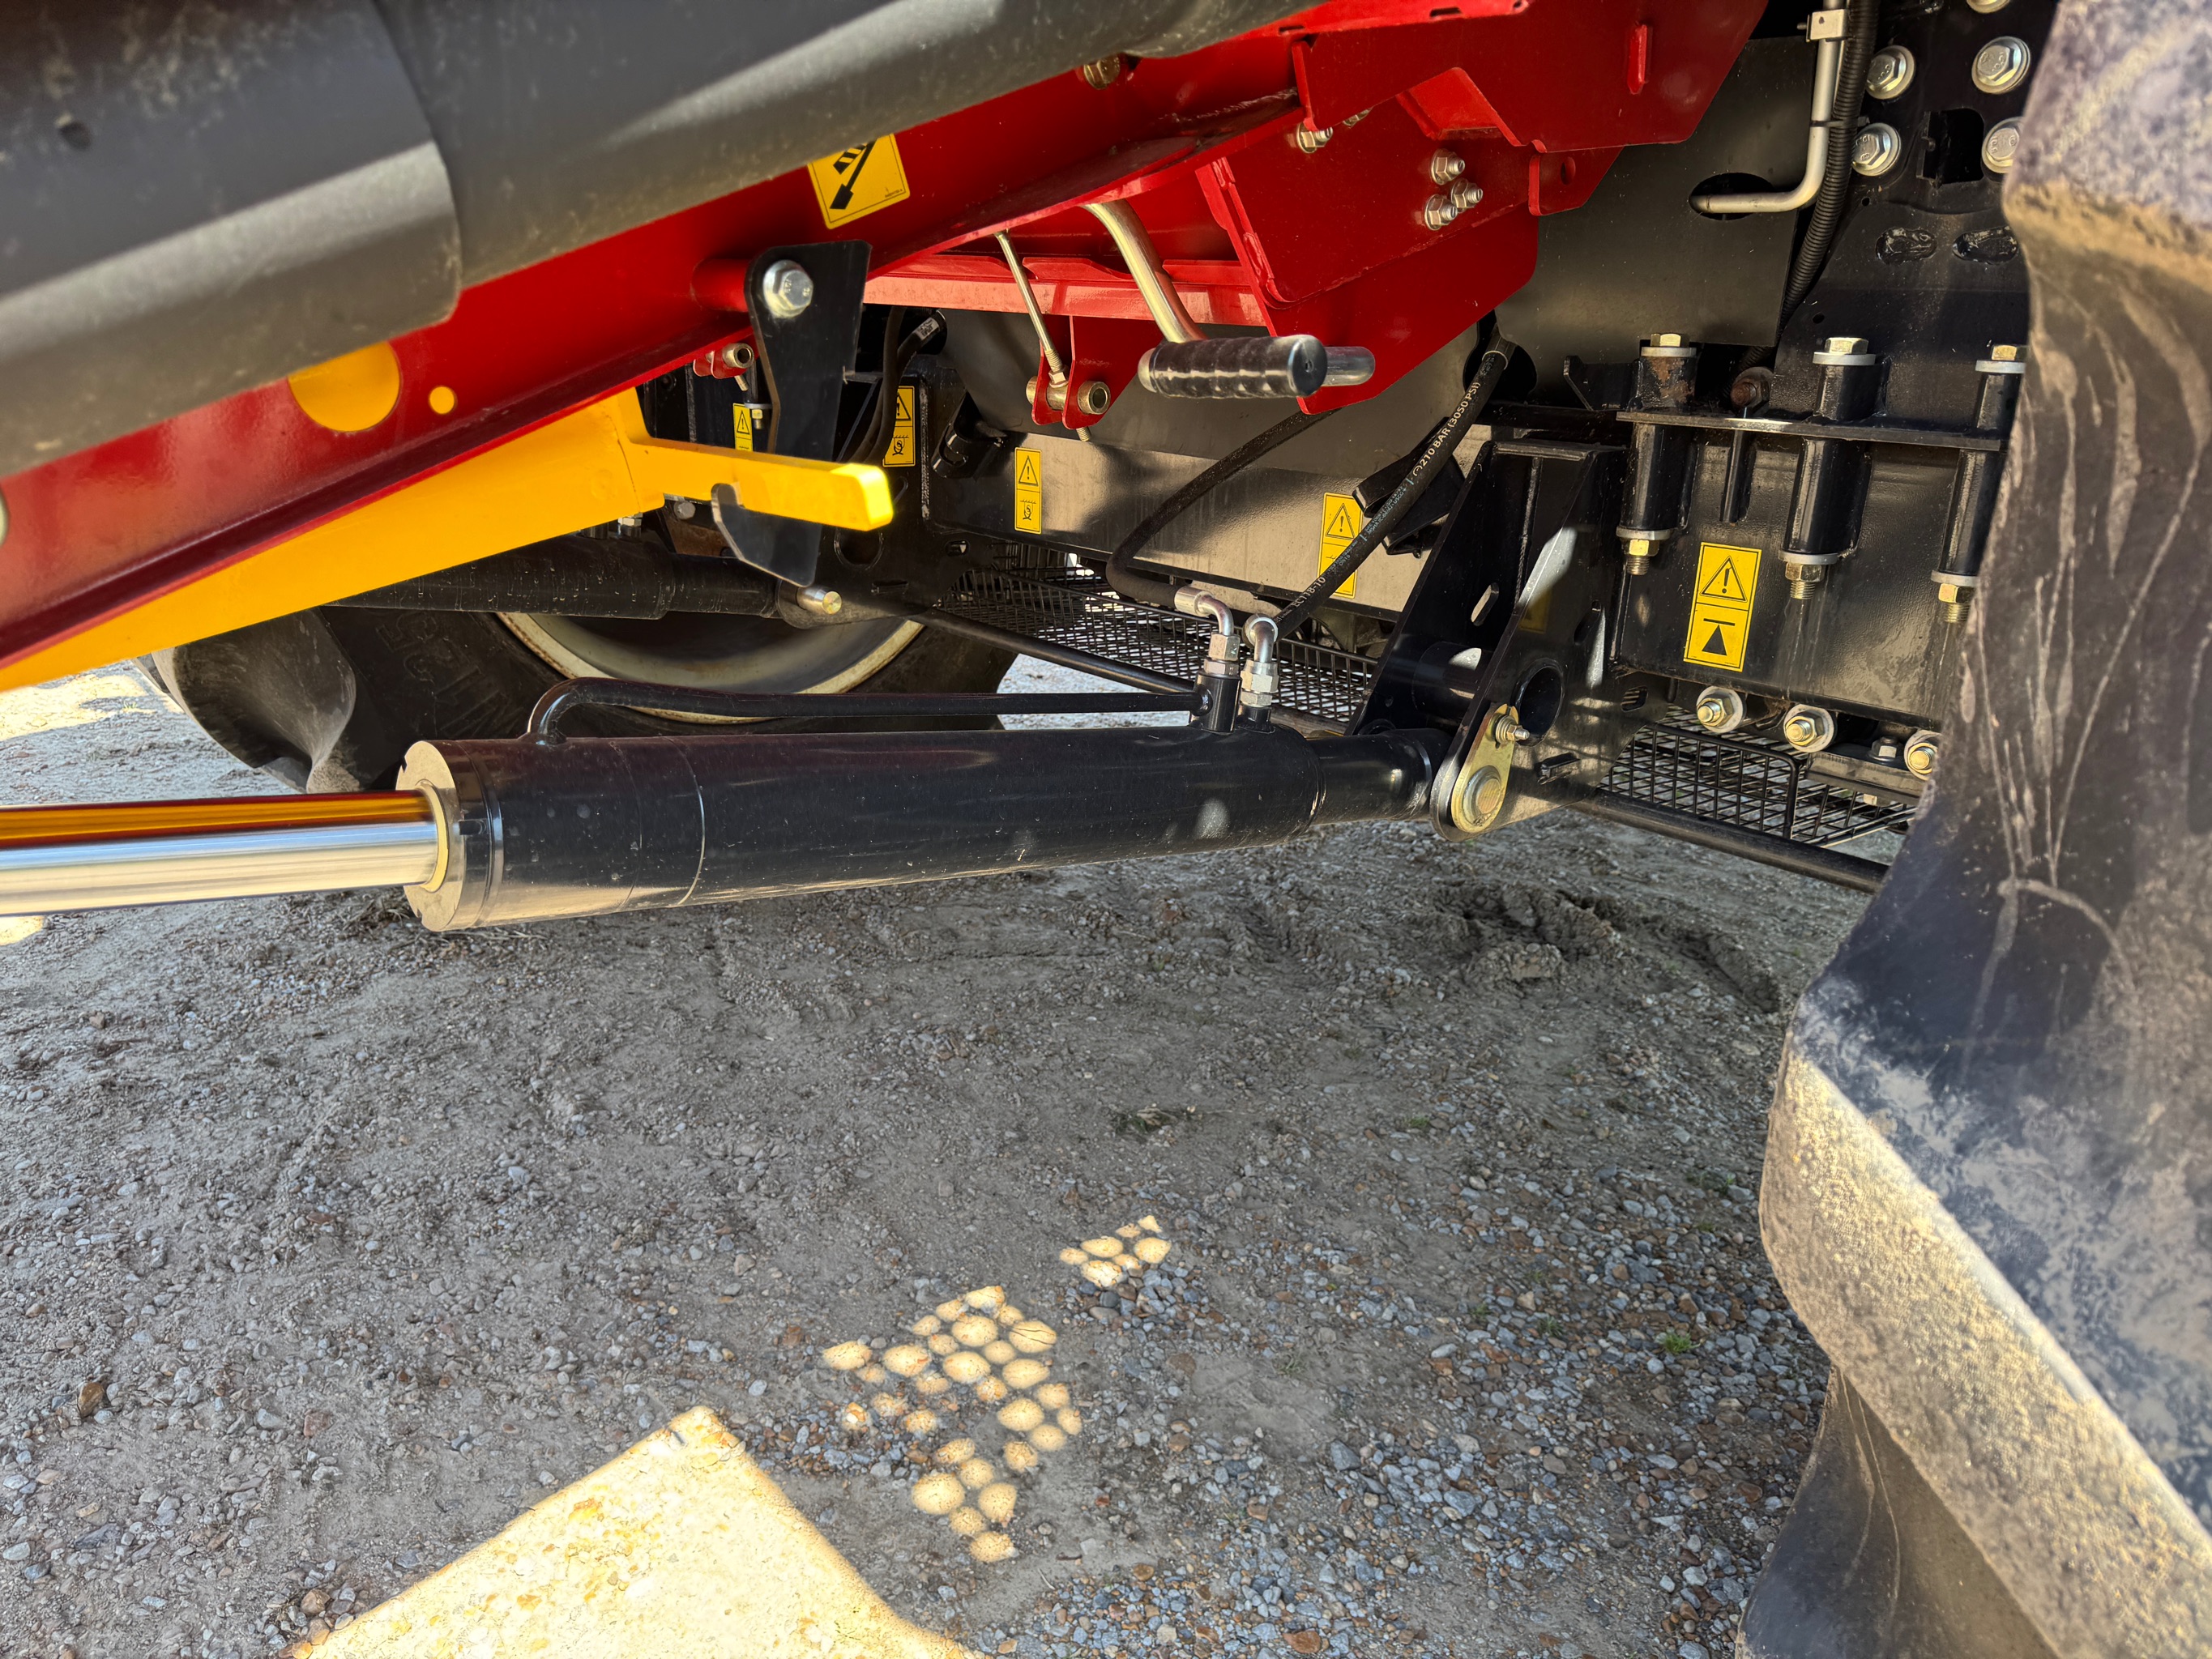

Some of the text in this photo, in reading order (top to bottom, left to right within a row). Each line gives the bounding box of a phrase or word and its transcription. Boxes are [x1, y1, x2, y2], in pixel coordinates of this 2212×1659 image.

[1419, 382, 1481, 467] 210 BAR (3050 PSI)
[1293, 577, 1326, 608] EC118-10
